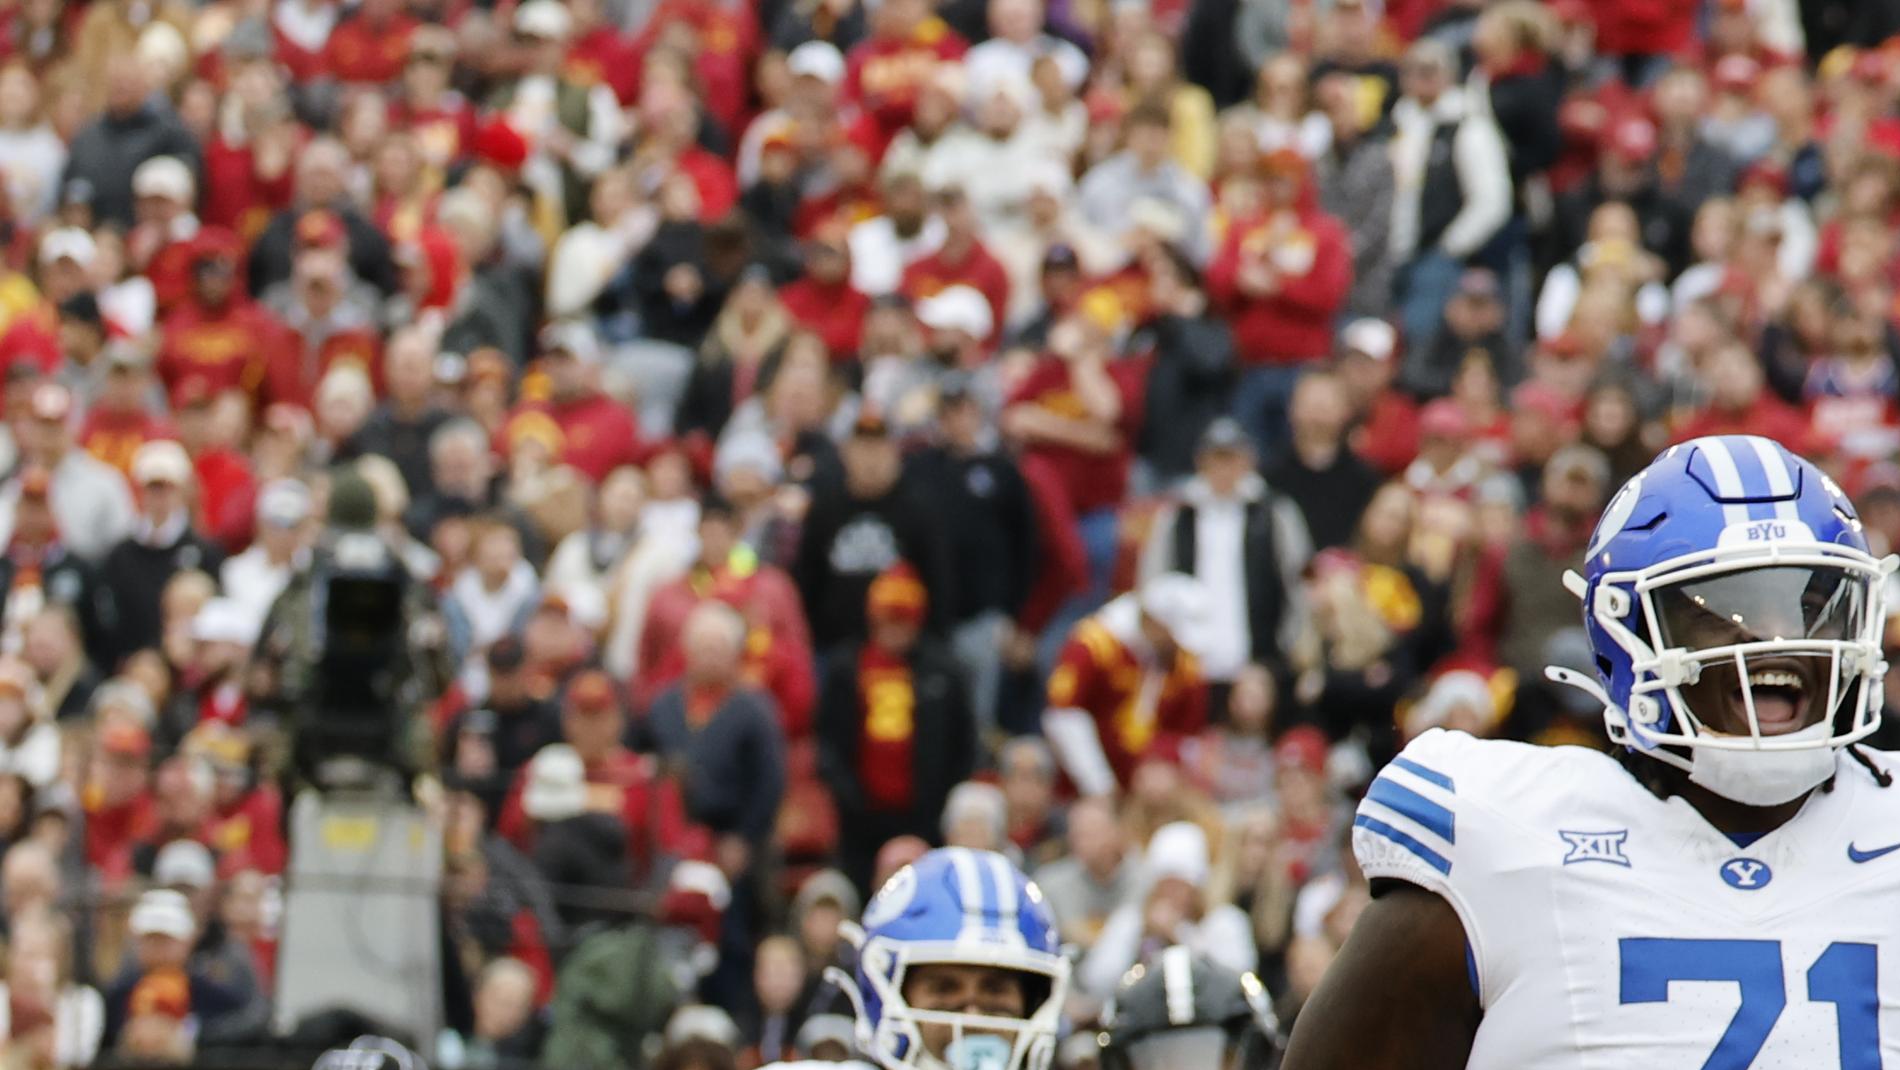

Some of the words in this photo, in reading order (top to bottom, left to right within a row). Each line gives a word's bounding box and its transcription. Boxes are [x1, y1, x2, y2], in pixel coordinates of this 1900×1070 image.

[1748, 522, 1786, 541] BYU
[1558, 829, 1632, 868] XII
[1728, 860, 1763, 886] Y
